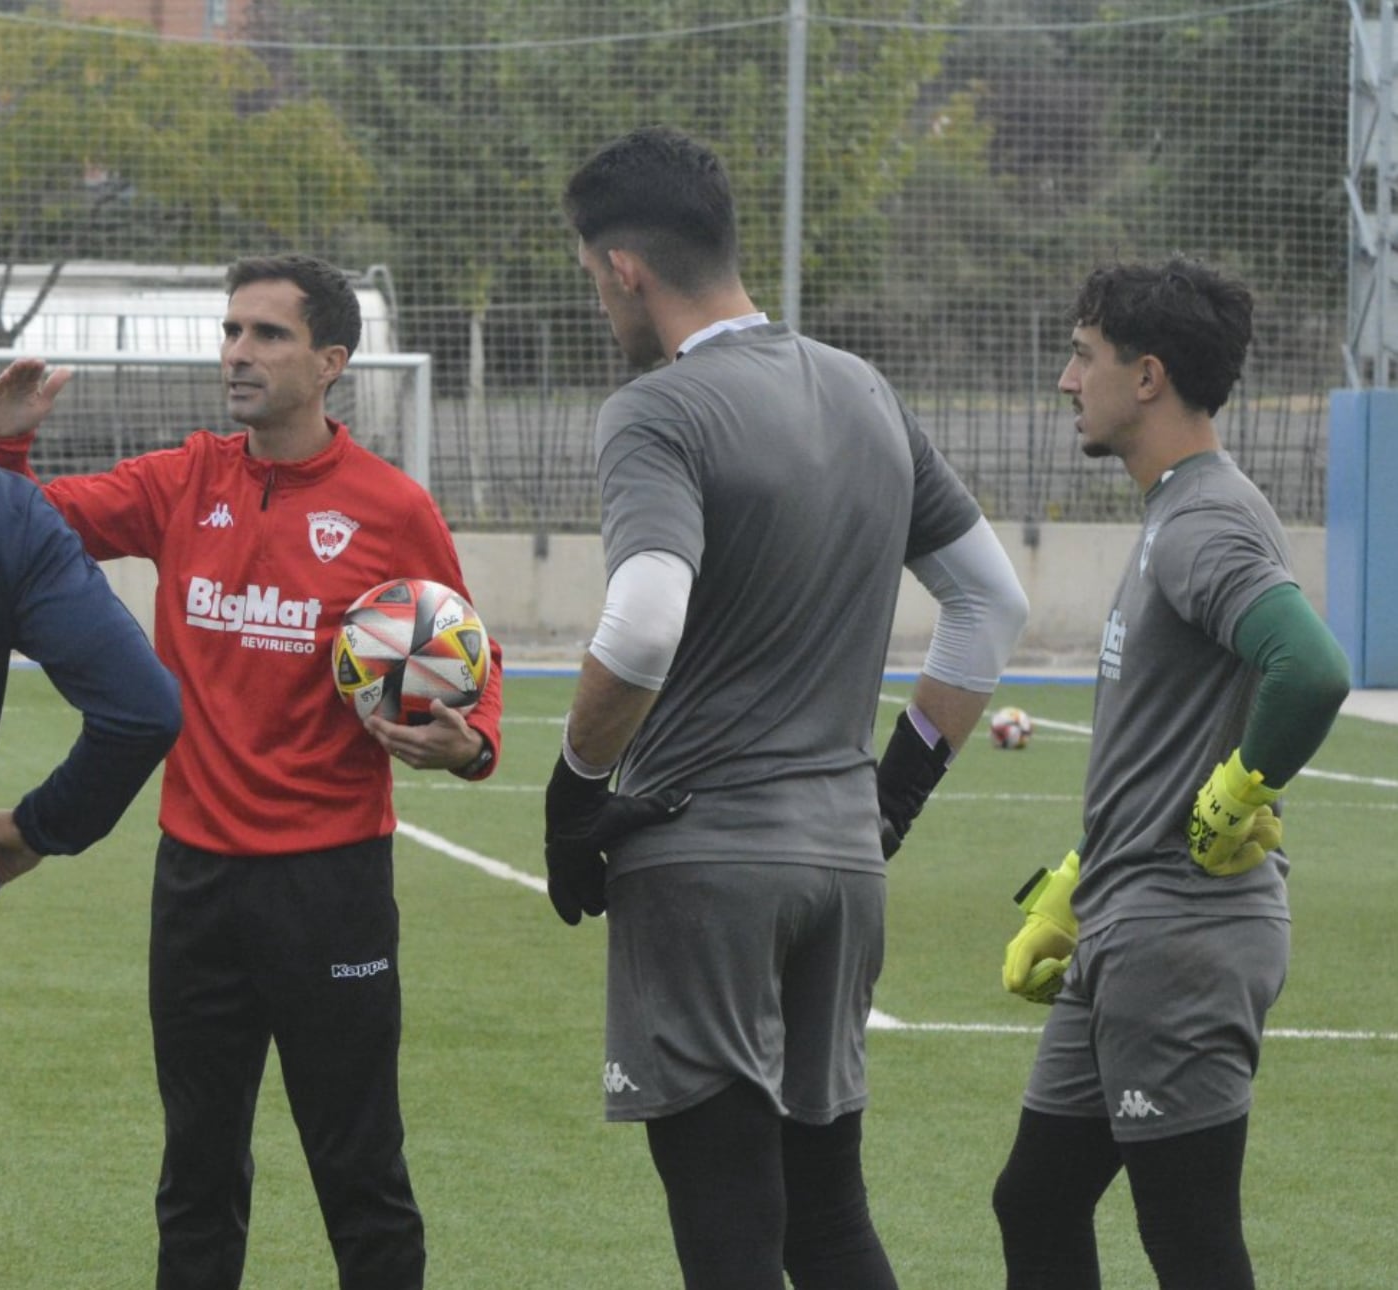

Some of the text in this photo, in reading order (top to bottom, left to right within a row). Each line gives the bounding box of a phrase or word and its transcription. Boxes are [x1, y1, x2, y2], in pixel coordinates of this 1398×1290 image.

[186, 575, 323, 632] BigMat
[240, 635, 316, 654] REVIRIEGO
[331, 958, 389, 978] Kappa
